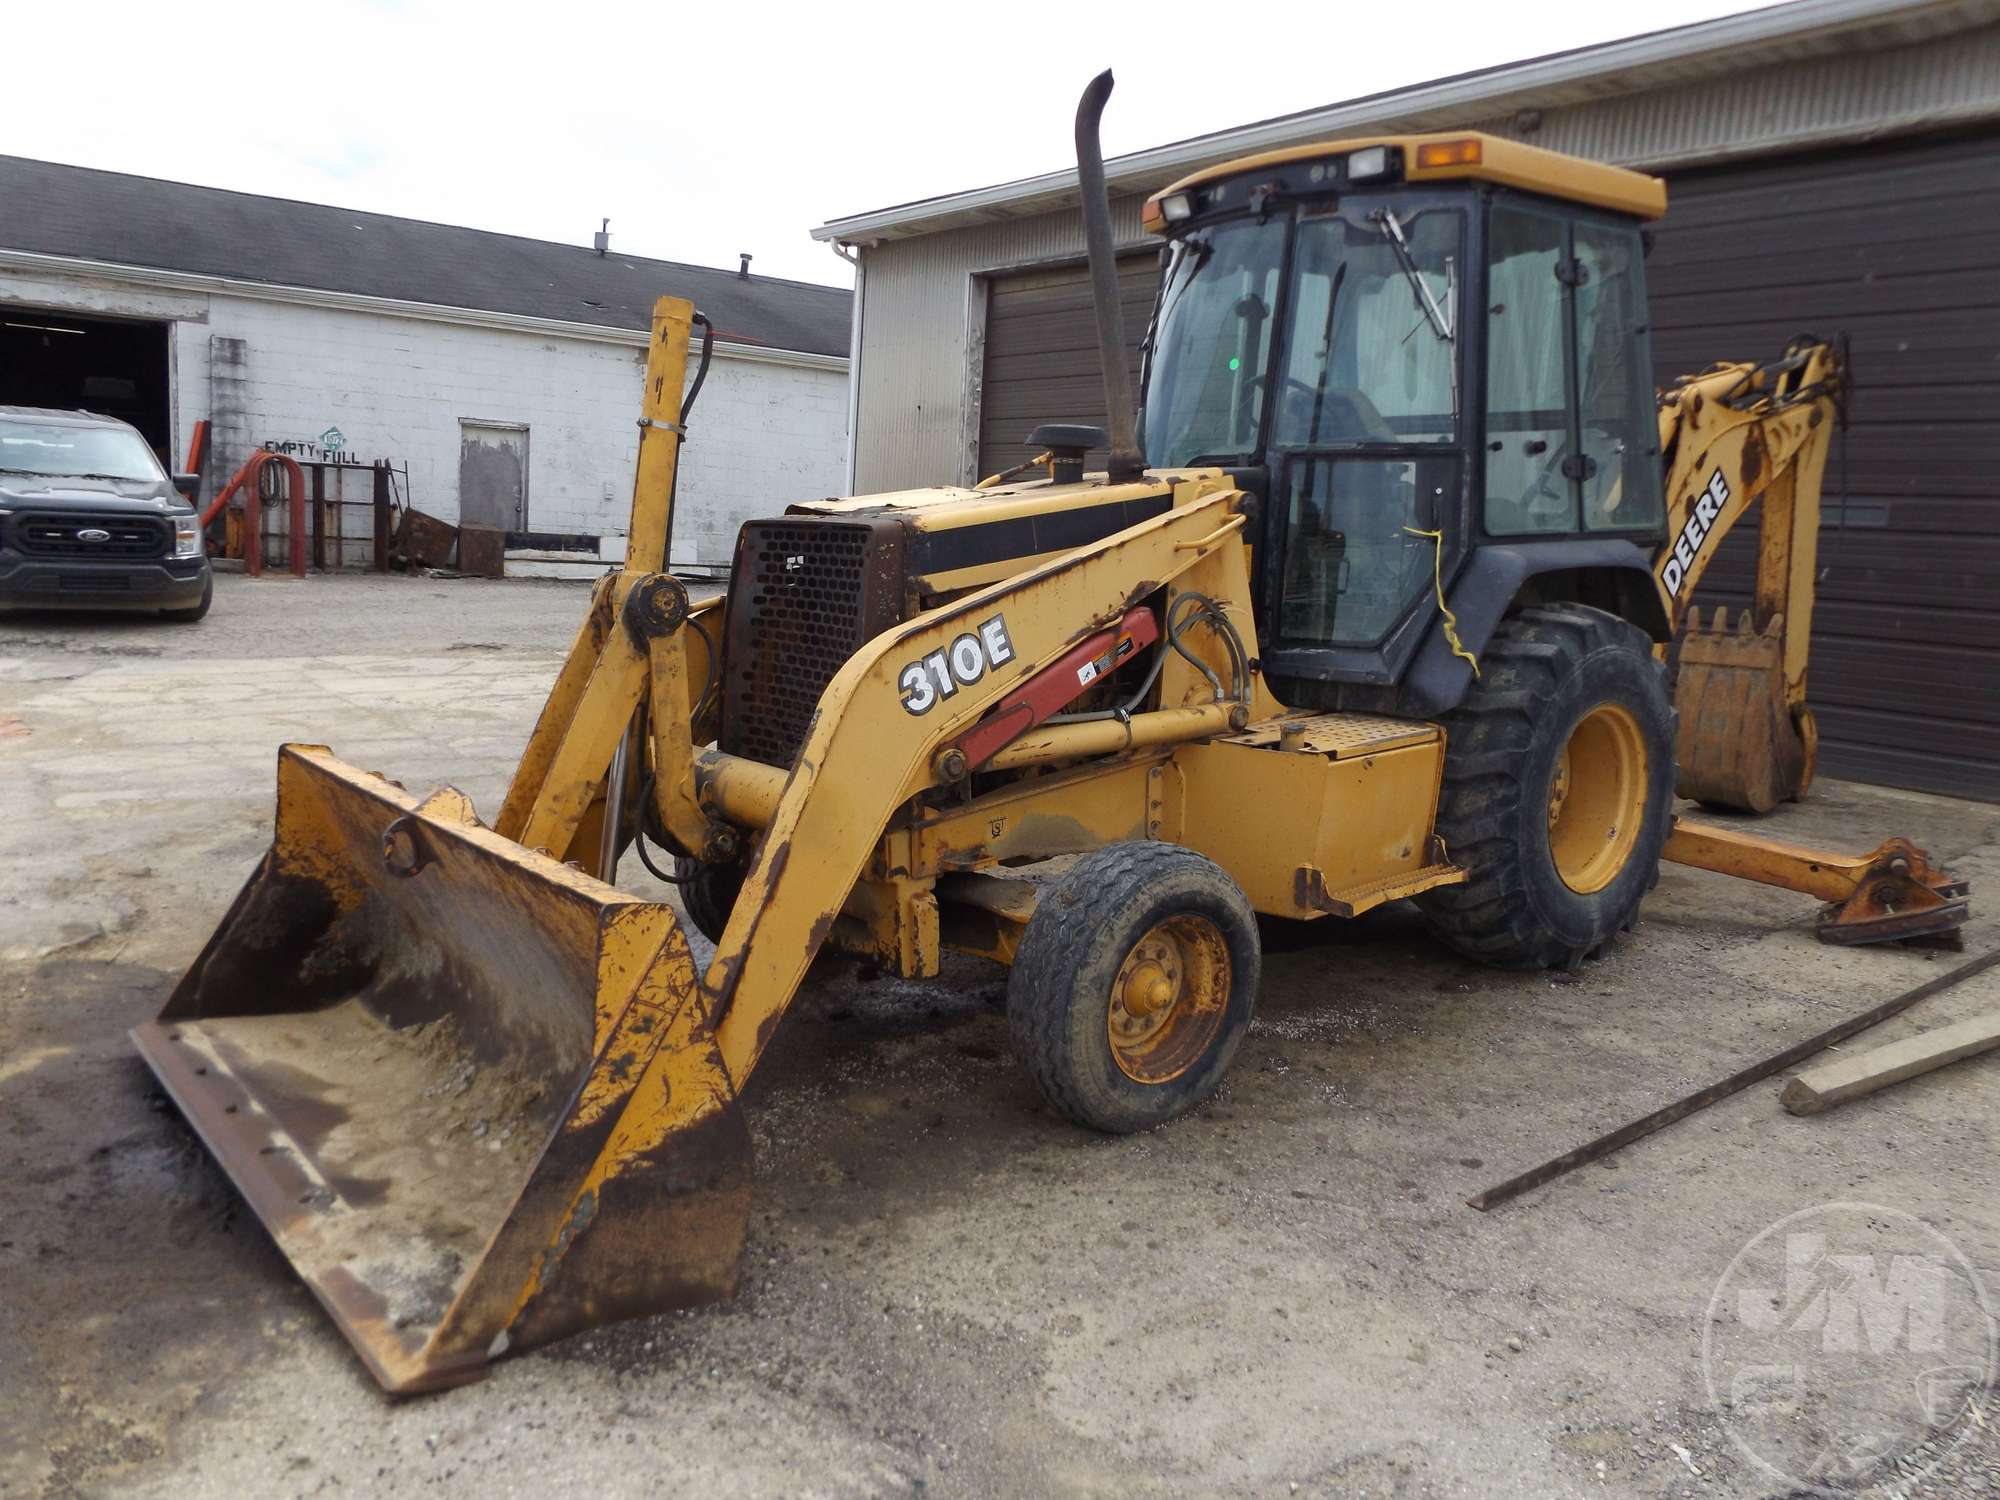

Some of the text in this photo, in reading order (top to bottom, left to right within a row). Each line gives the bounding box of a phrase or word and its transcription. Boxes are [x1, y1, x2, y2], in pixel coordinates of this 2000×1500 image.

[264, 440, 316, 457] EMPTY
[323, 449, 360, 465] FULL
[1662, 468, 1730, 598] DEERE
[900, 615, 1015, 714] 310E
